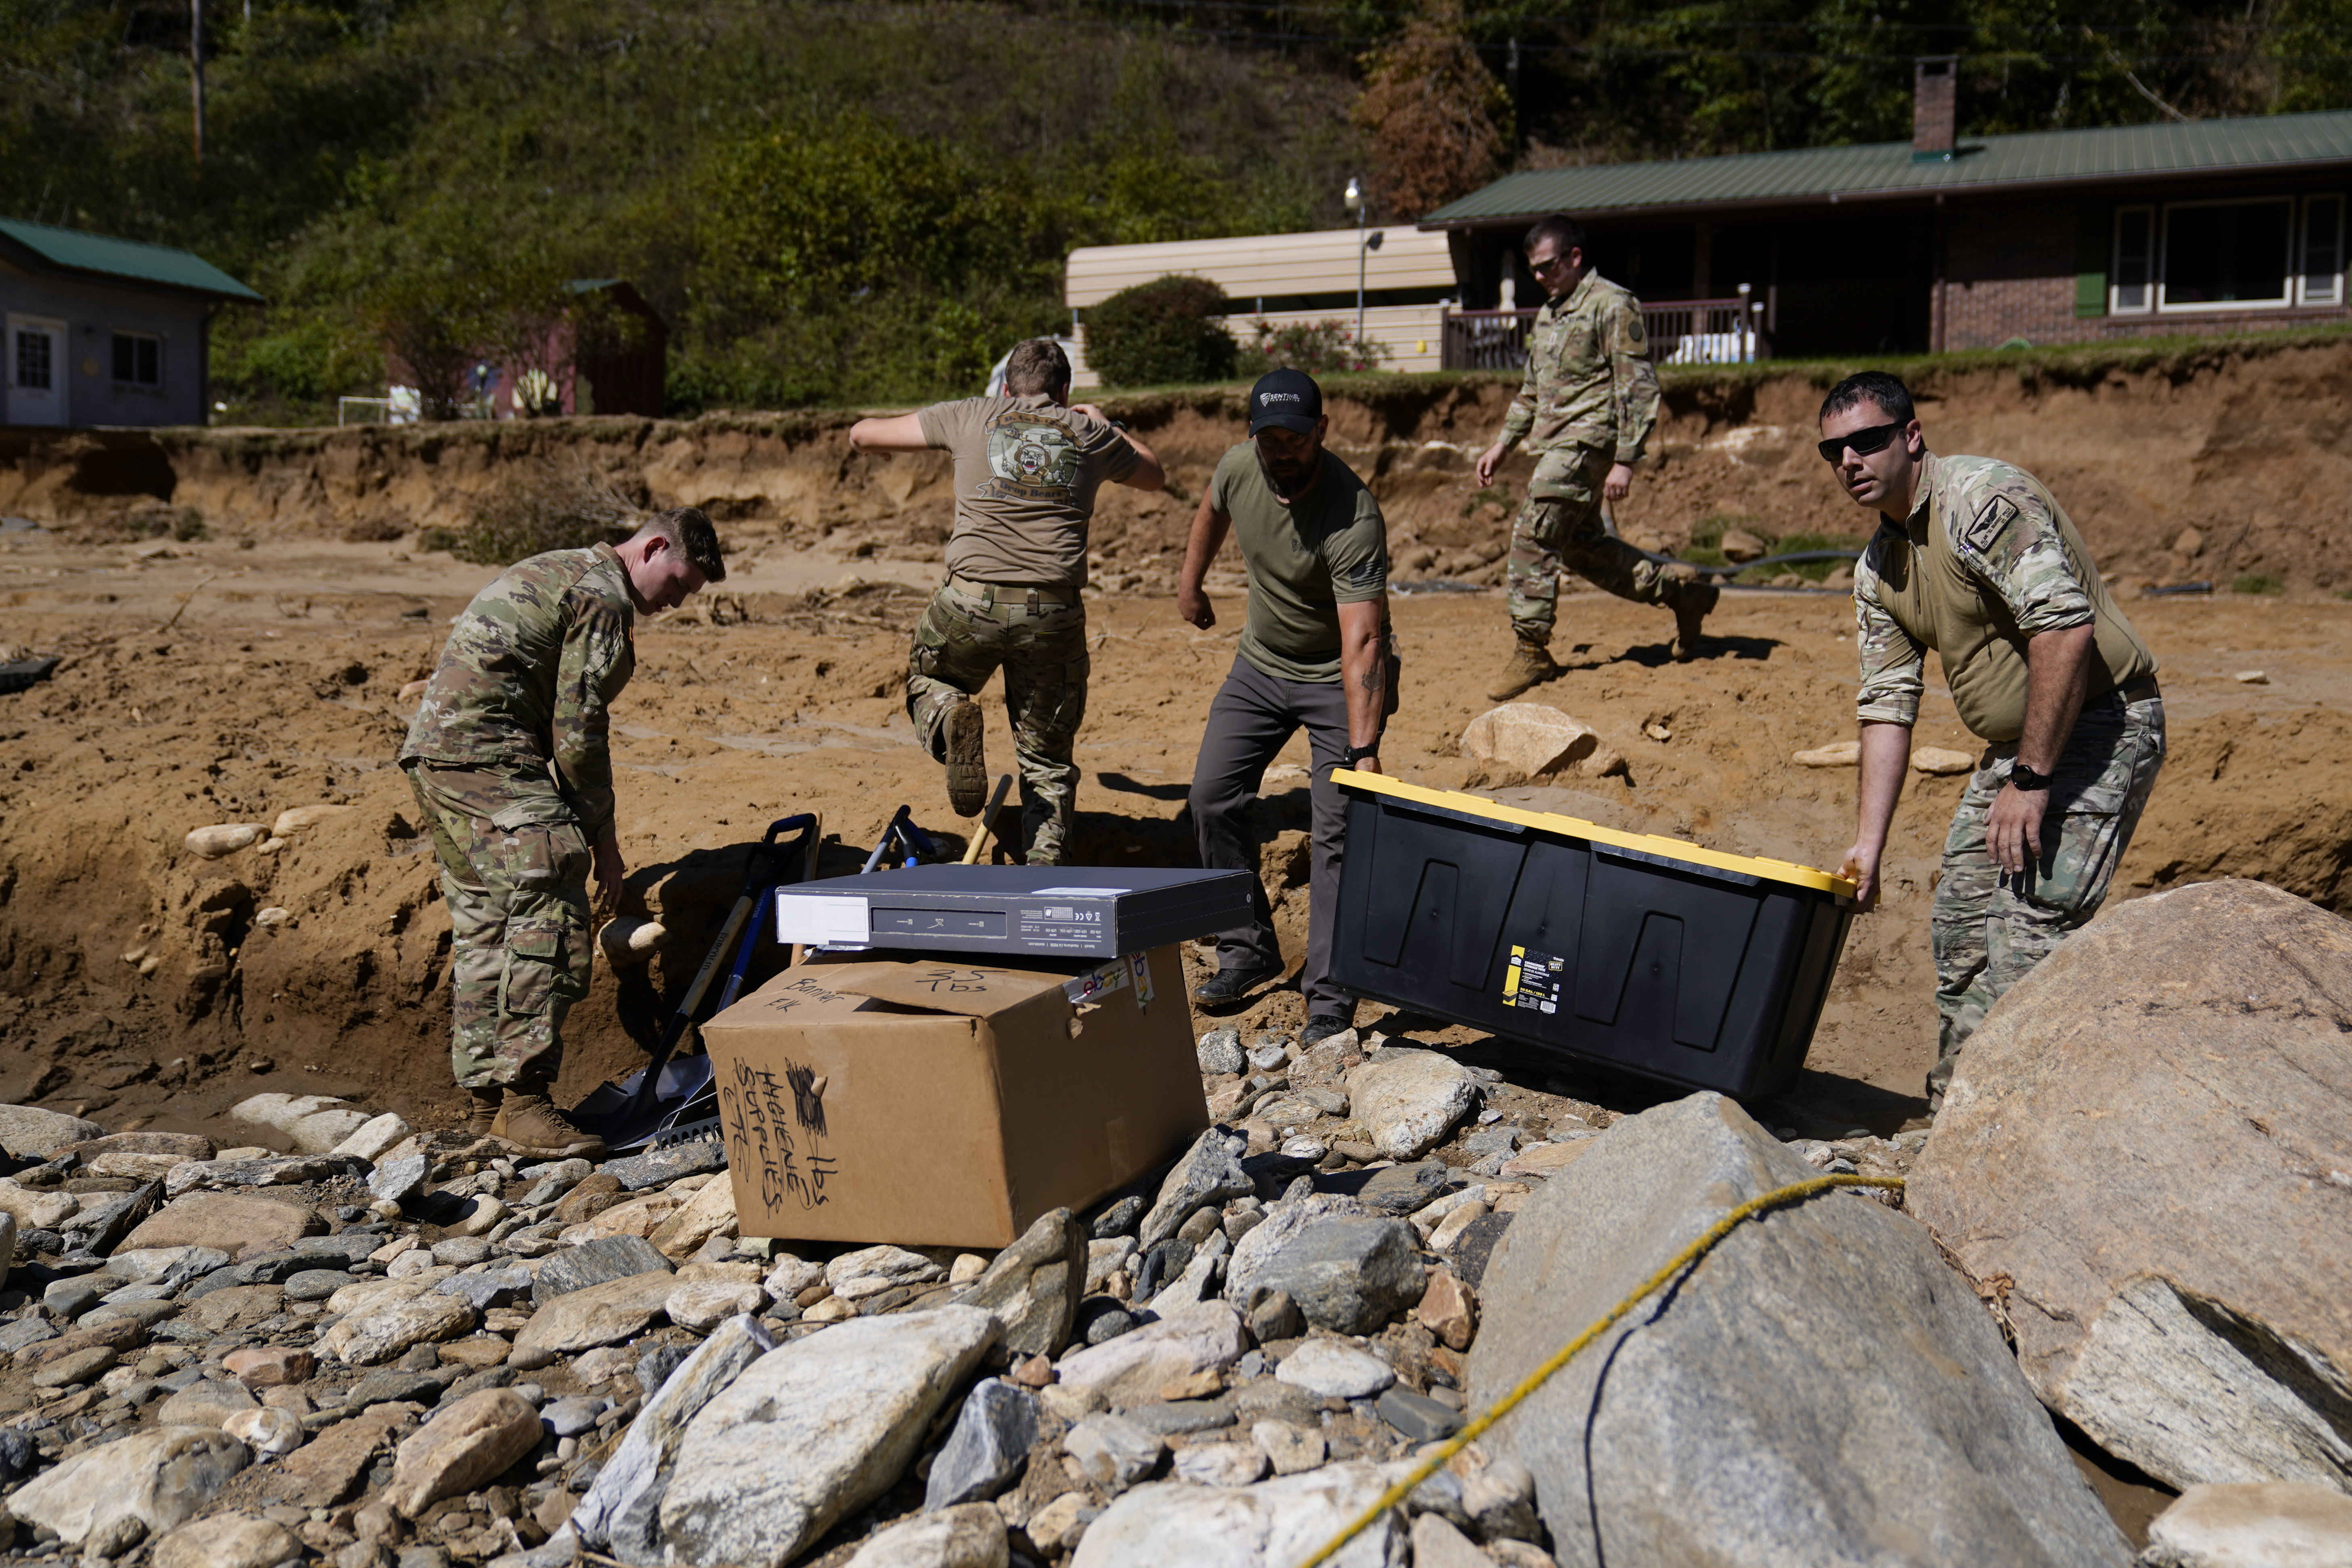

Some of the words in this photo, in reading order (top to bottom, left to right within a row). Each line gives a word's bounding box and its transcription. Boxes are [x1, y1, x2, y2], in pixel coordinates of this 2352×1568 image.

[1000, 480, 1027, 496] Drop
[2002, 507, 2011, 516] PECK
[2006, 508, 2015, 518] ARMY
[783, 978, 845, 1003] Banner
[764, 998, 801, 1013] Elk
[734, 1057, 783, 1208] SUPPLIES
[755, 1070, 810, 1205] HYGIENE
[807, 1156, 839, 1206] lbs
